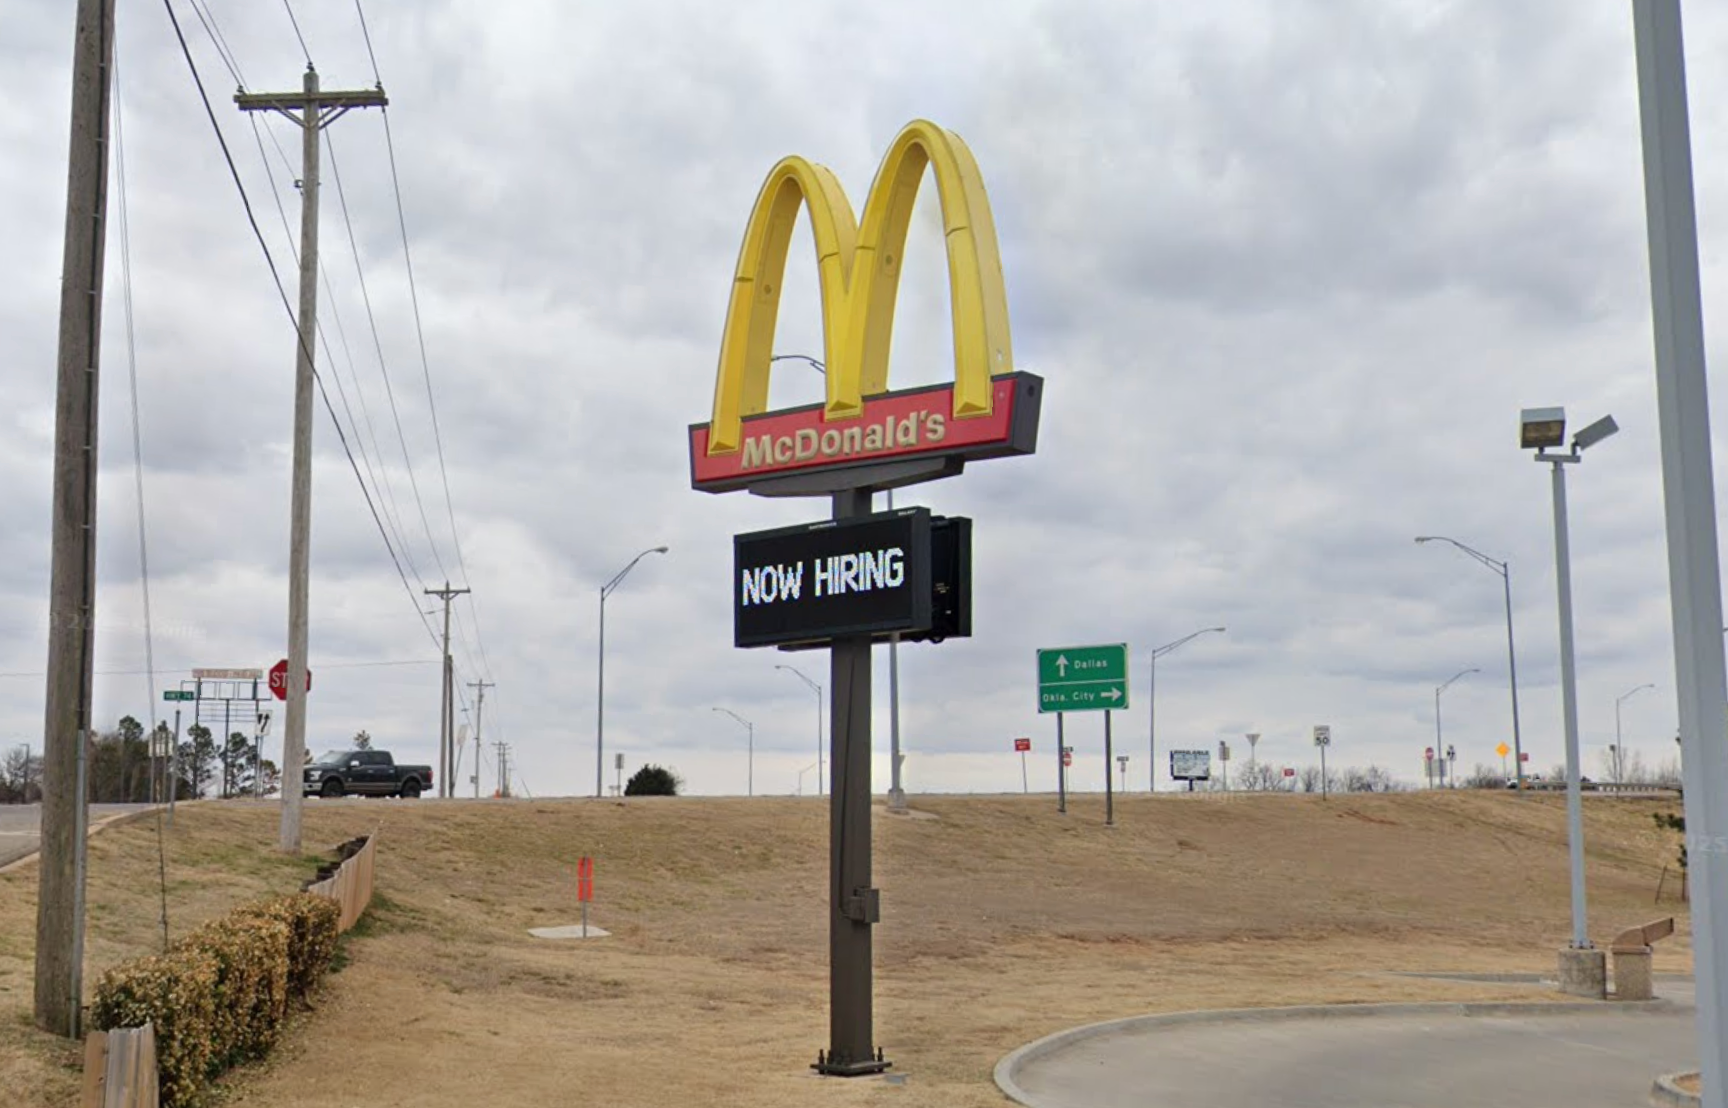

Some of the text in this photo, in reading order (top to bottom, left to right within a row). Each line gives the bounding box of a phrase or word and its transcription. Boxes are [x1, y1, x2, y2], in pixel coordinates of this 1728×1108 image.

[741, 410, 945, 469] McDonald's
[742, 547, 904, 606] NOW HIRING
[1074, 659, 1107, 669] Dallas
[1073, 690, 1095, 701] City
